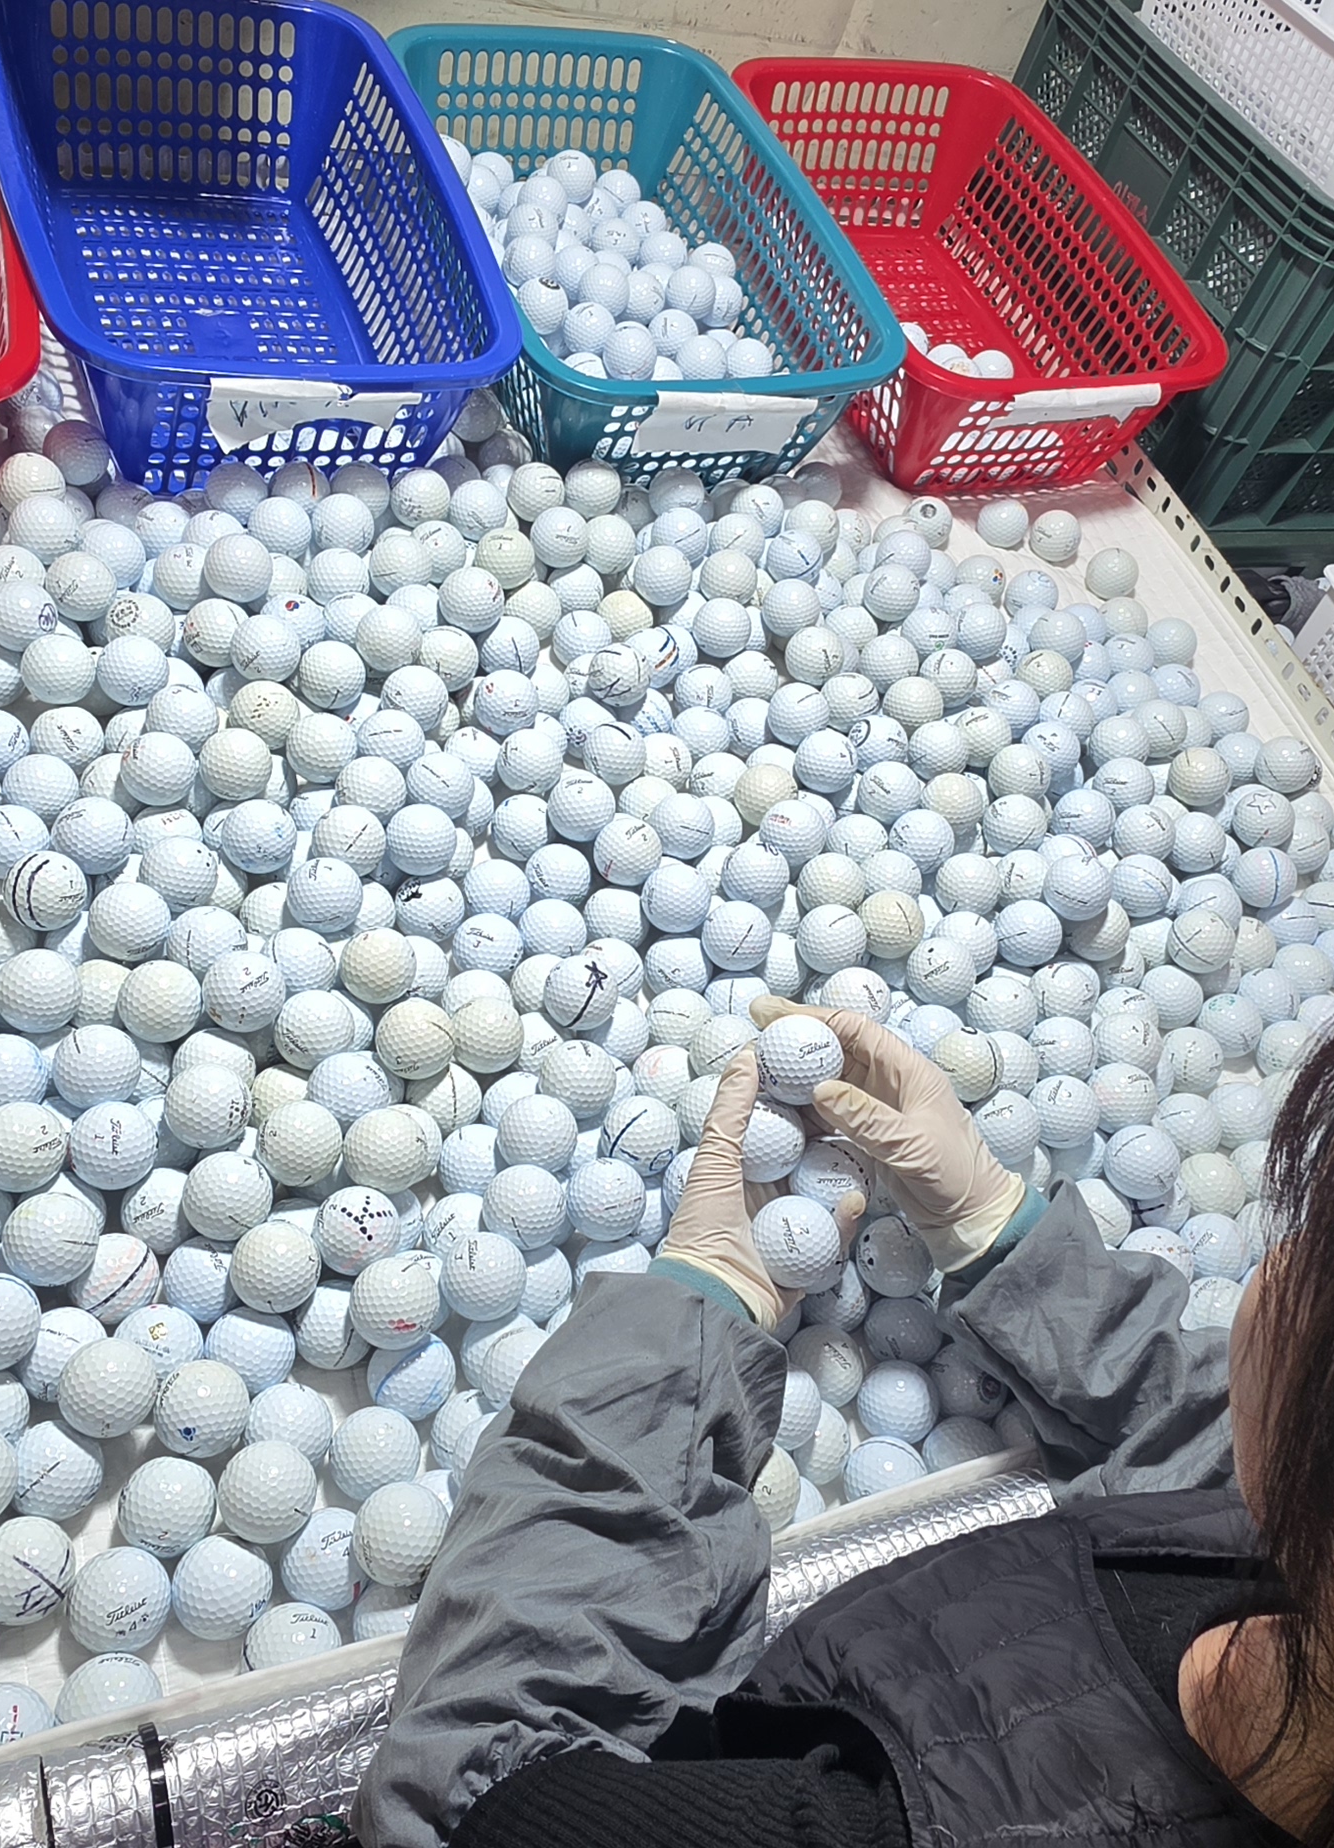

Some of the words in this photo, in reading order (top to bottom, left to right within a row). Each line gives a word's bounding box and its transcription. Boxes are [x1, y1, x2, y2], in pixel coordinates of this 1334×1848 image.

[15, 570, 24, 579] 2
[242, 966, 251, 975] 2
[799, 1041, 831, 1062] Titleist
[819, 1058, 824, 1068] 1
[40, 1125, 48, 1135] 2
[139, 1196, 146, 1205] 2
[799, 1226, 809, 1236] 2
[448, 1232, 457, 1241] 1
[106, 1597, 147, 1626] Titleist
[309, 1628, 317, 1639] 1
